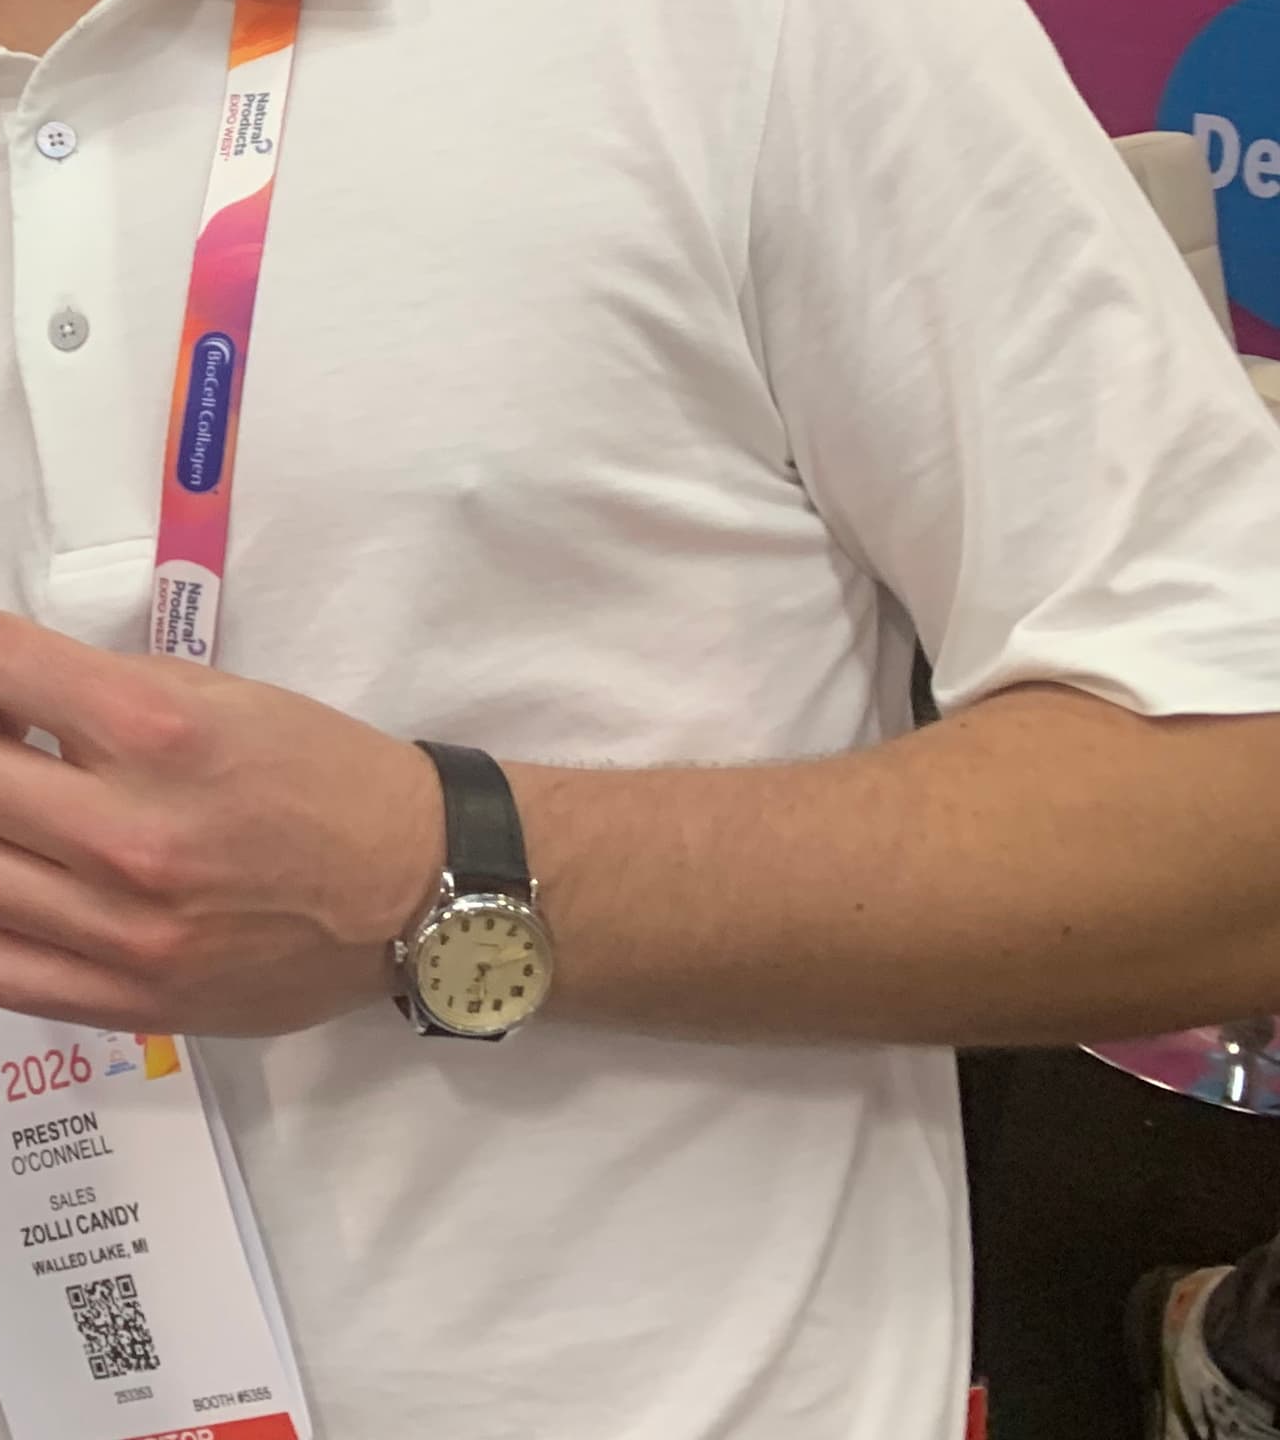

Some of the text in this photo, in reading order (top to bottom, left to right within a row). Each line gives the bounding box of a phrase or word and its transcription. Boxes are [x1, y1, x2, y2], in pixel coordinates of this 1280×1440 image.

[226, 94, 240, 125] EXPO
[233, 93, 256, 156] Products
[250, 92, 270, 144] Natural
[190, 350, 222, 486] BioCell Collagen
[165, 579, 187, 653] Products
[182, 582, 203, 644] Natural
[0, 1044, 93, 1103] 2026
[11, 1112, 99, 1150] PRESTON
[11, 1135, 114, 1176] O'CONNELL
[48, 1186, 97, 1212] SALES
[20, 1202, 141, 1247] ZOLLI CANDY
[32, 1251, 87, 1277] WALLED
[192, 1392, 236, 1412] BOOTH
